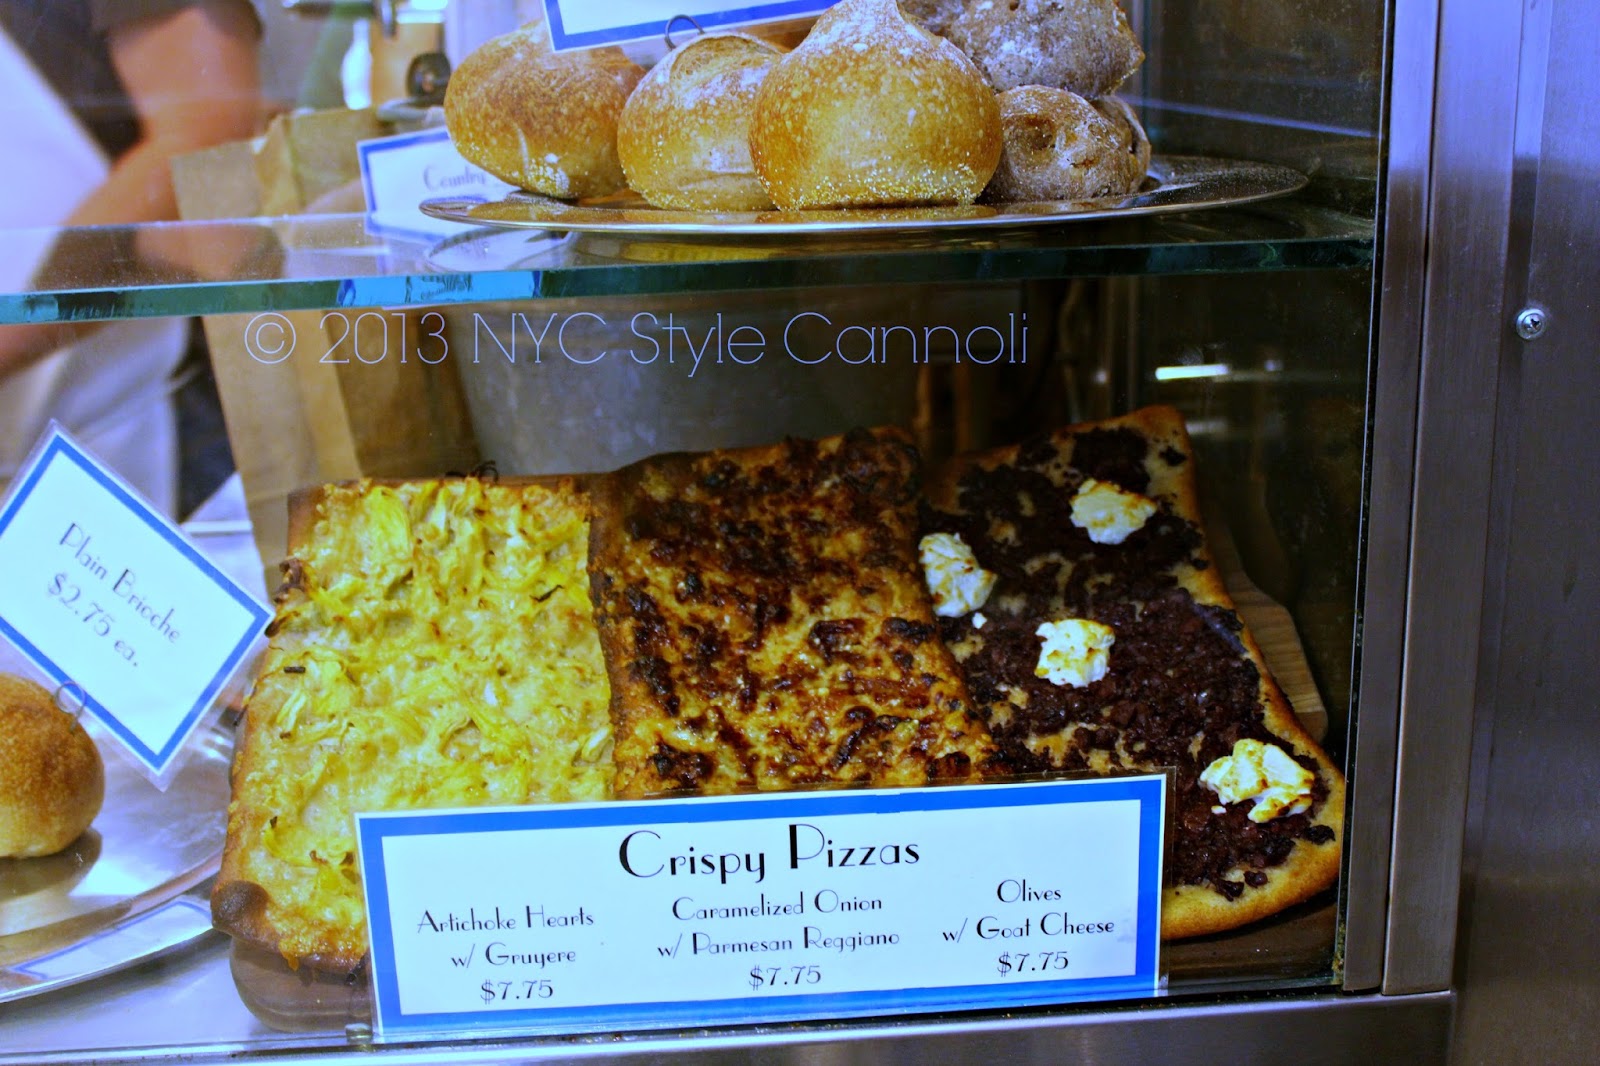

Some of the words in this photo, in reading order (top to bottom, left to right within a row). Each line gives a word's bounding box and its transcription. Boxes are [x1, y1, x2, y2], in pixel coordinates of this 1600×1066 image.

[58, 522, 107, 580] Plain
[112, 568, 181, 644] Brioche
[48, 571, 115, 637] $2.75
[113, 639, 138, 667] ea.
[618, 829, 766, 884] Crispy
[788, 823, 921, 869] Pizzas
[672, 891, 803, 921] Caramelized
[814, 889, 882, 913] Onion
[997, 879, 1062, 903] Olives
[416, 907, 516, 933] Artichoke
[526, 904, 594, 928] Hearts
[942, 917, 968, 943] w/
[976, 915, 1031, 940] Goat
[1040, 912, 1114, 936] Cheese
[451, 944, 475, 968] w/
[485, 942, 576, 969] Gruyere
[657, 933, 683, 959] w/
[692, 930, 793, 956] Parmesan
[803, 926, 900, 953] Reggiano
[748, 964, 822, 991] $7.75
[997, 951, 1069, 977] $7.75
[481, 979, 554, 1005] $7.75
